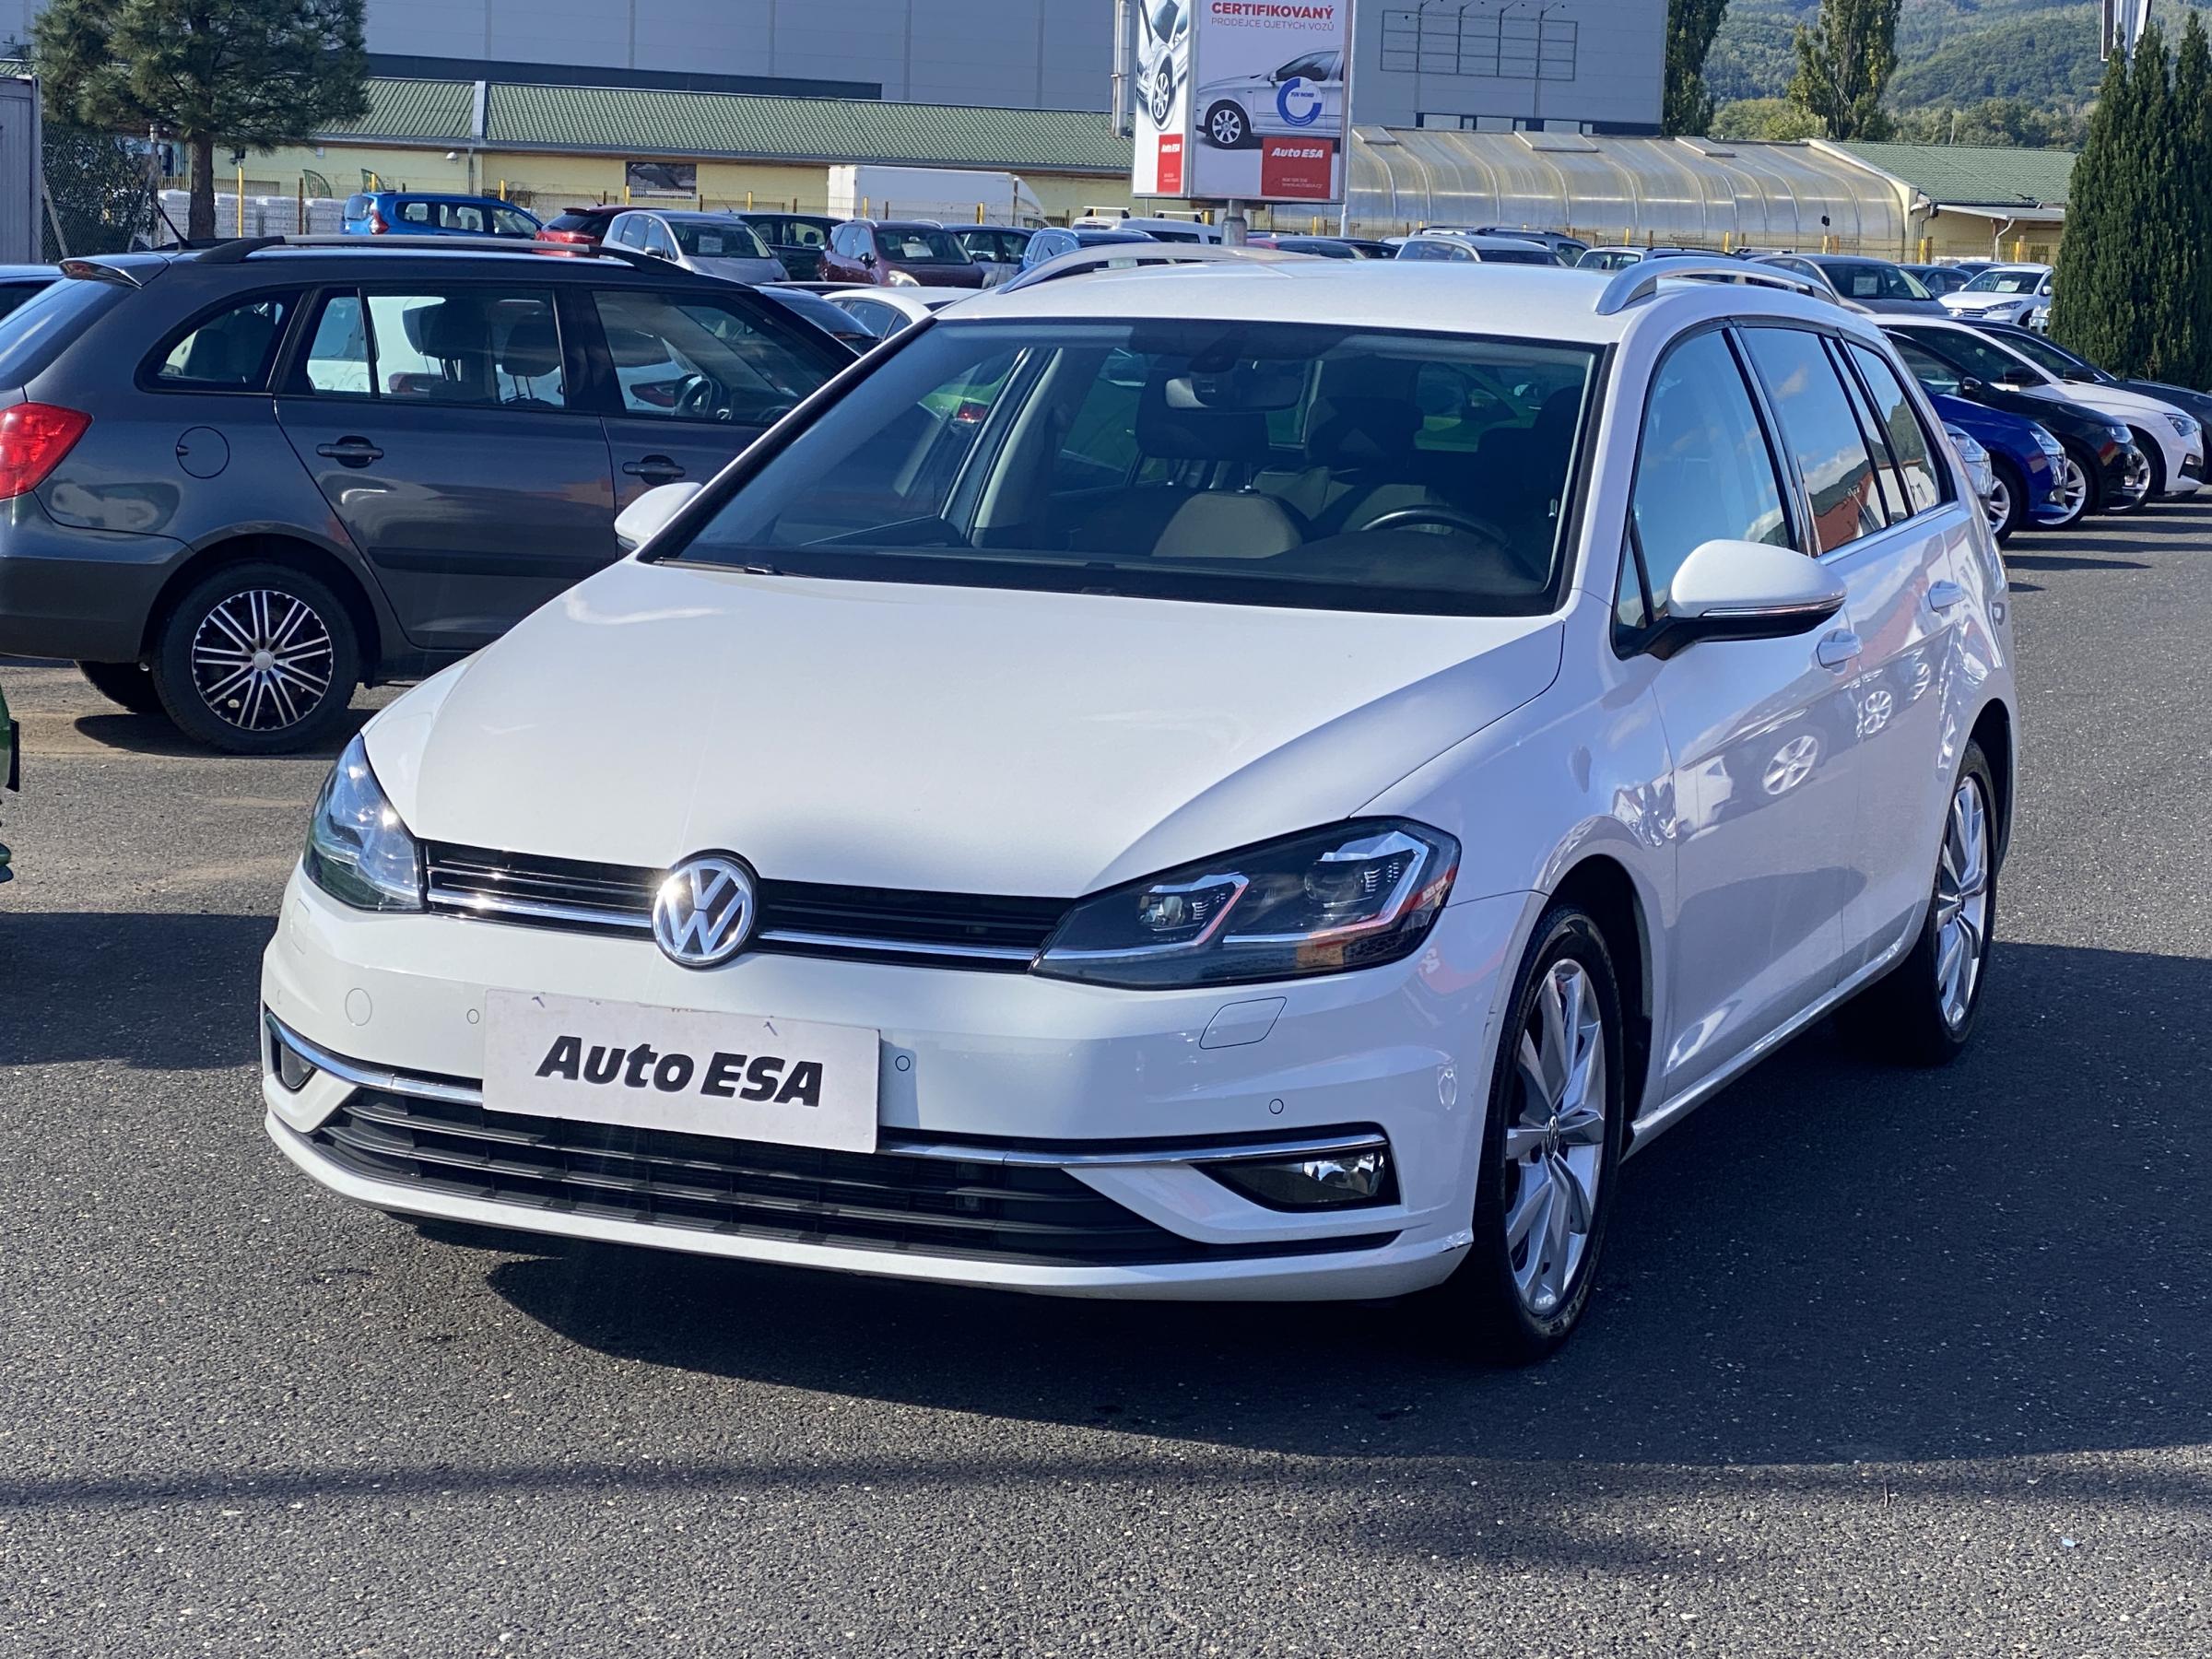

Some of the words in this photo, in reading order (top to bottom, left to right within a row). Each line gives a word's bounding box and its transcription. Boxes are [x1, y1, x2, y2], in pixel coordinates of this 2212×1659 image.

[1212, 2, 1334, 19] CERTIFIKOVANÝ
[1211, 18, 1261, 28] PRODEJCE
[1272, 147, 1300, 157] Auto
[1301, 148, 1324, 159] ESA
[535, 1035, 694, 1092] Auto
[700, 1052, 823, 1108] ESA
